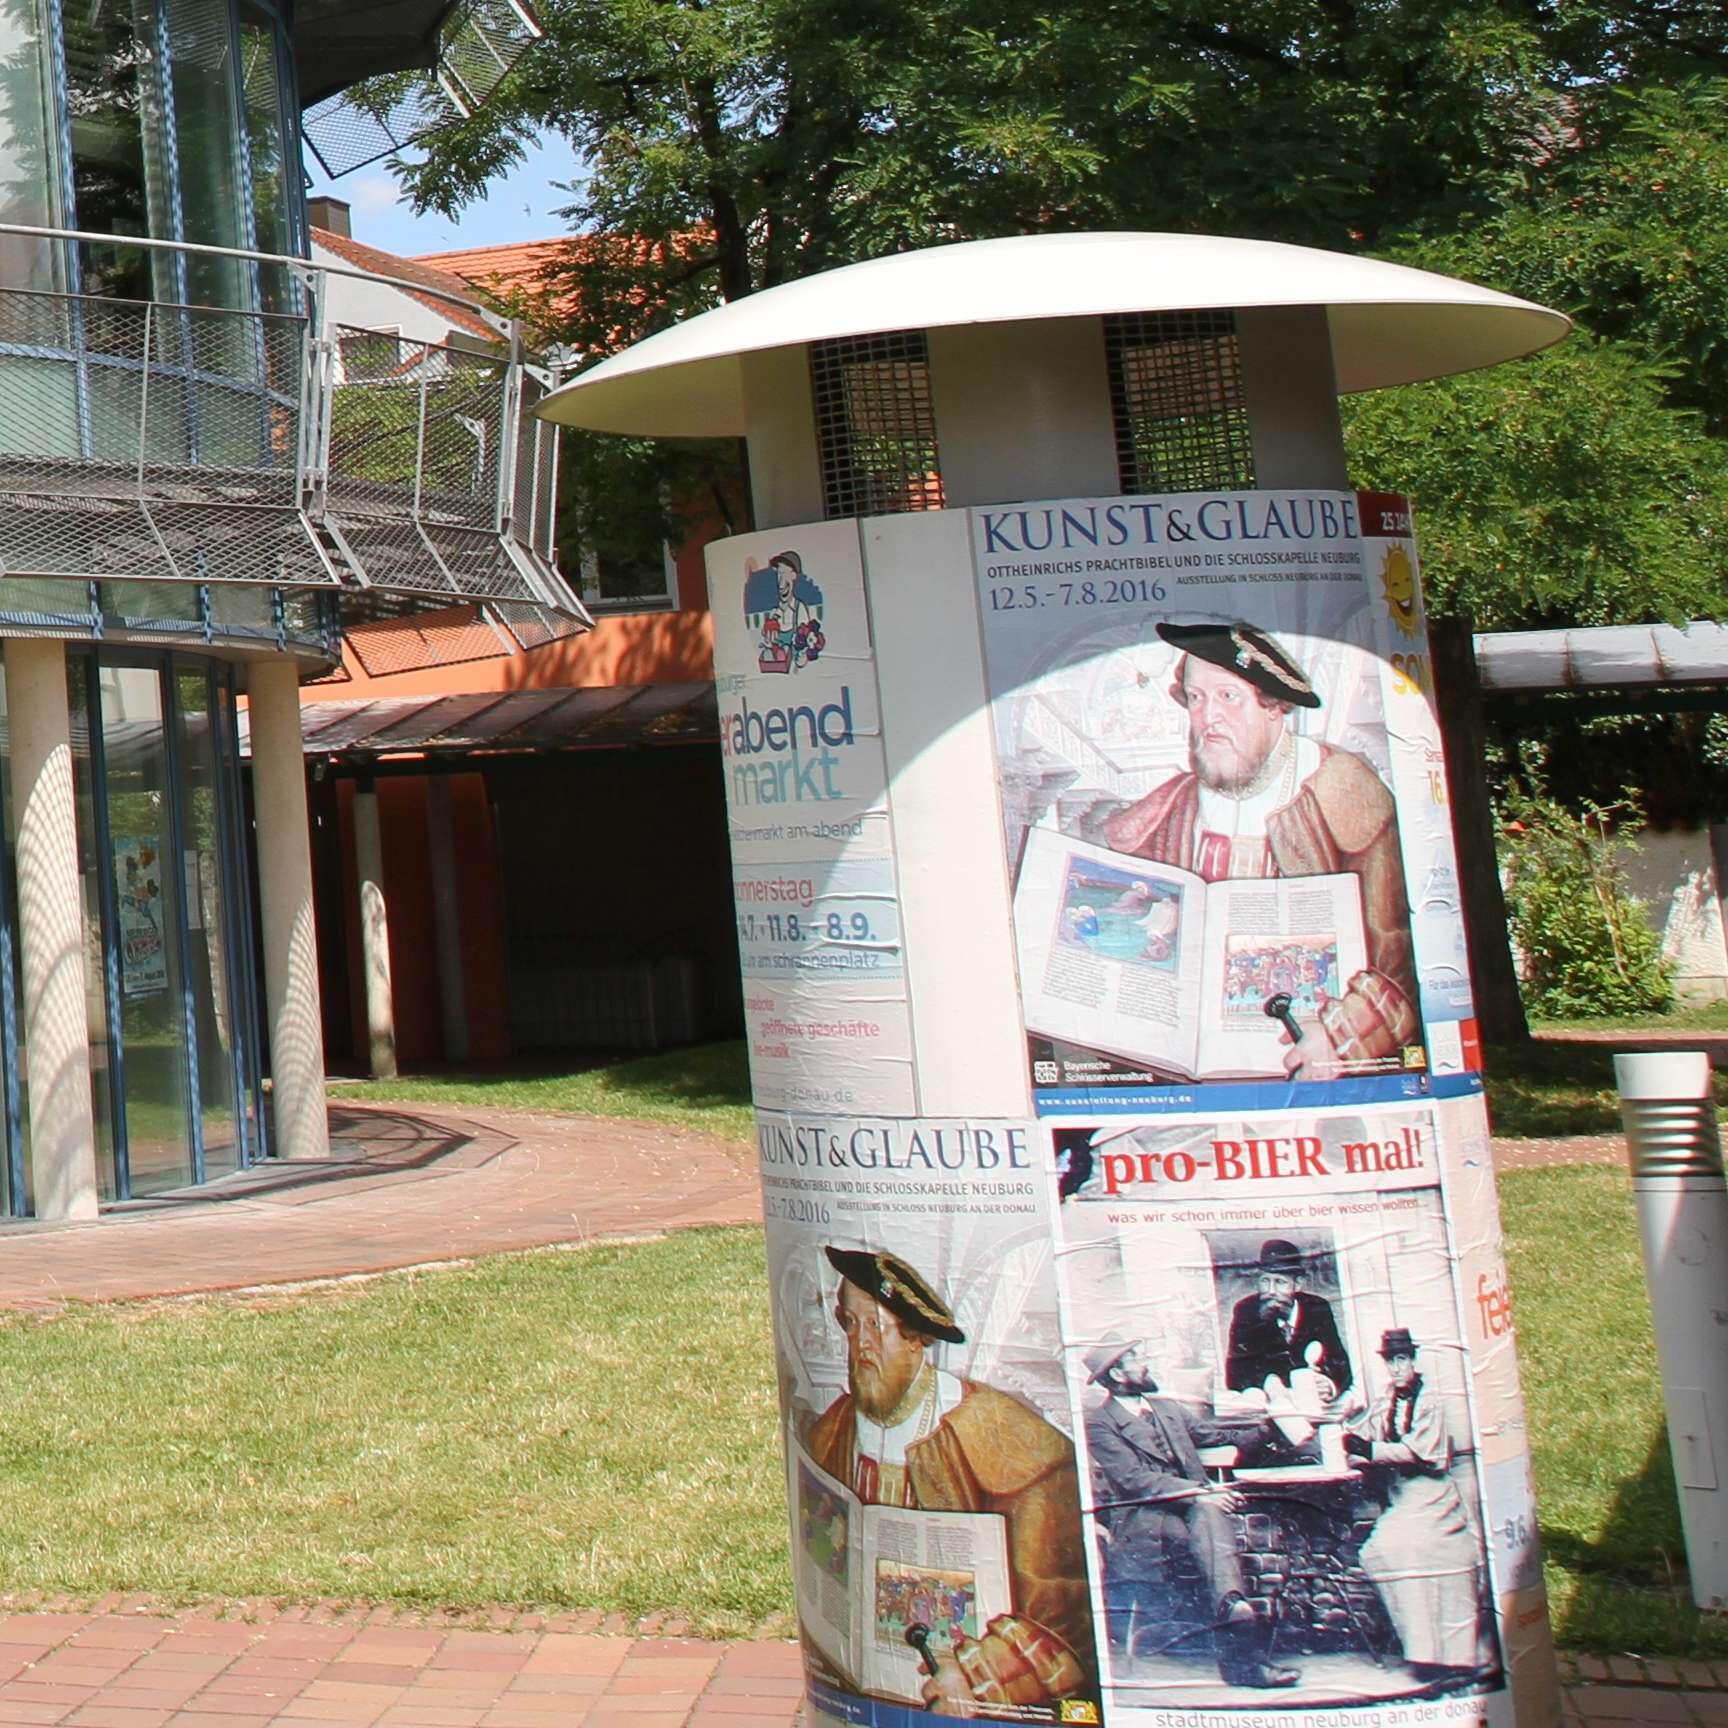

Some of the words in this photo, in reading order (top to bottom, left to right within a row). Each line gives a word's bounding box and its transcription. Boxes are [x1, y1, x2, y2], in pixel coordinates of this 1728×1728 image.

[979, 499, 1358, 554] KUNST&GLAUBE
[987, 560, 1082, 579] OTTHEINRICHS
[1086, 556, 1172, 573] PRACHTBIBEL
[1174, 554, 1201, 568] UND
[1205, 553, 1224, 566] DIE
[1227, 552, 1319, 565] SCHLOSSKAPELLE
[1321, 552, 1361, 564] NEUBURG
[1177, 574, 1237, 585] AUSSTELLUNG
[1249, 573, 1284, 582] SCHLOSS
[989, 577, 1166, 611] 12.5.-7.8.2016
[733, 746, 842, 806] markt
[786, 824, 809, 839] am
[813, 819, 863, 838] abend
[766, 913, 806, 942] 11.8.
[827, 912, 877, 941] 8.9.
[807, 1020, 881, 1040] geschäfte
[1063, 1060, 1111, 1073] Bayerische
[1064, 1071, 1154, 1083] Schlösserverwaltung
[1038, 1095, 1193, 1107] www.ausstellung-neuburg.de
[1099, 1136, 1332, 1195] pro-BIER
[1341, 1127, 1424, 1174] mal!
[834, 1180, 853, 1193] UND
[855, 1181, 871, 1194] DIE
[872, 1182, 969, 1196] SCHLOSSKAPELLE
[971, 1182, 1034, 1196] NEUBURG
[892, 1202, 926, 1213] SCHLOSS
[928, 1203, 968, 1214] NEUBURG
[969, 1203, 982, 1214] AN
[983, 1203, 1001, 1214] DER
[1003, 1203, 1036, 1214] DONAU
[1107, 1213, 1137, 1223] was
[1142, 1212, 1166, 1223] wir
[1171, 1209, 1215, 1223] schon
[1220, 1208, 1266, 1221] immer
[1273, 1205, 1304, 1218] über
[1309, 1204, 1335, 1216] bier
[1337, 1202, 1378, 1215] wissen
[1155, 1712, 1296, 1728] stadtmuseum
[1303, 1711, 1381, 1727] neuburg
[1387, 1710, 1408, 1724] an
[1414, 1706, 1441, 1722] der
[1445, 1700, 1489, 1718] donau
